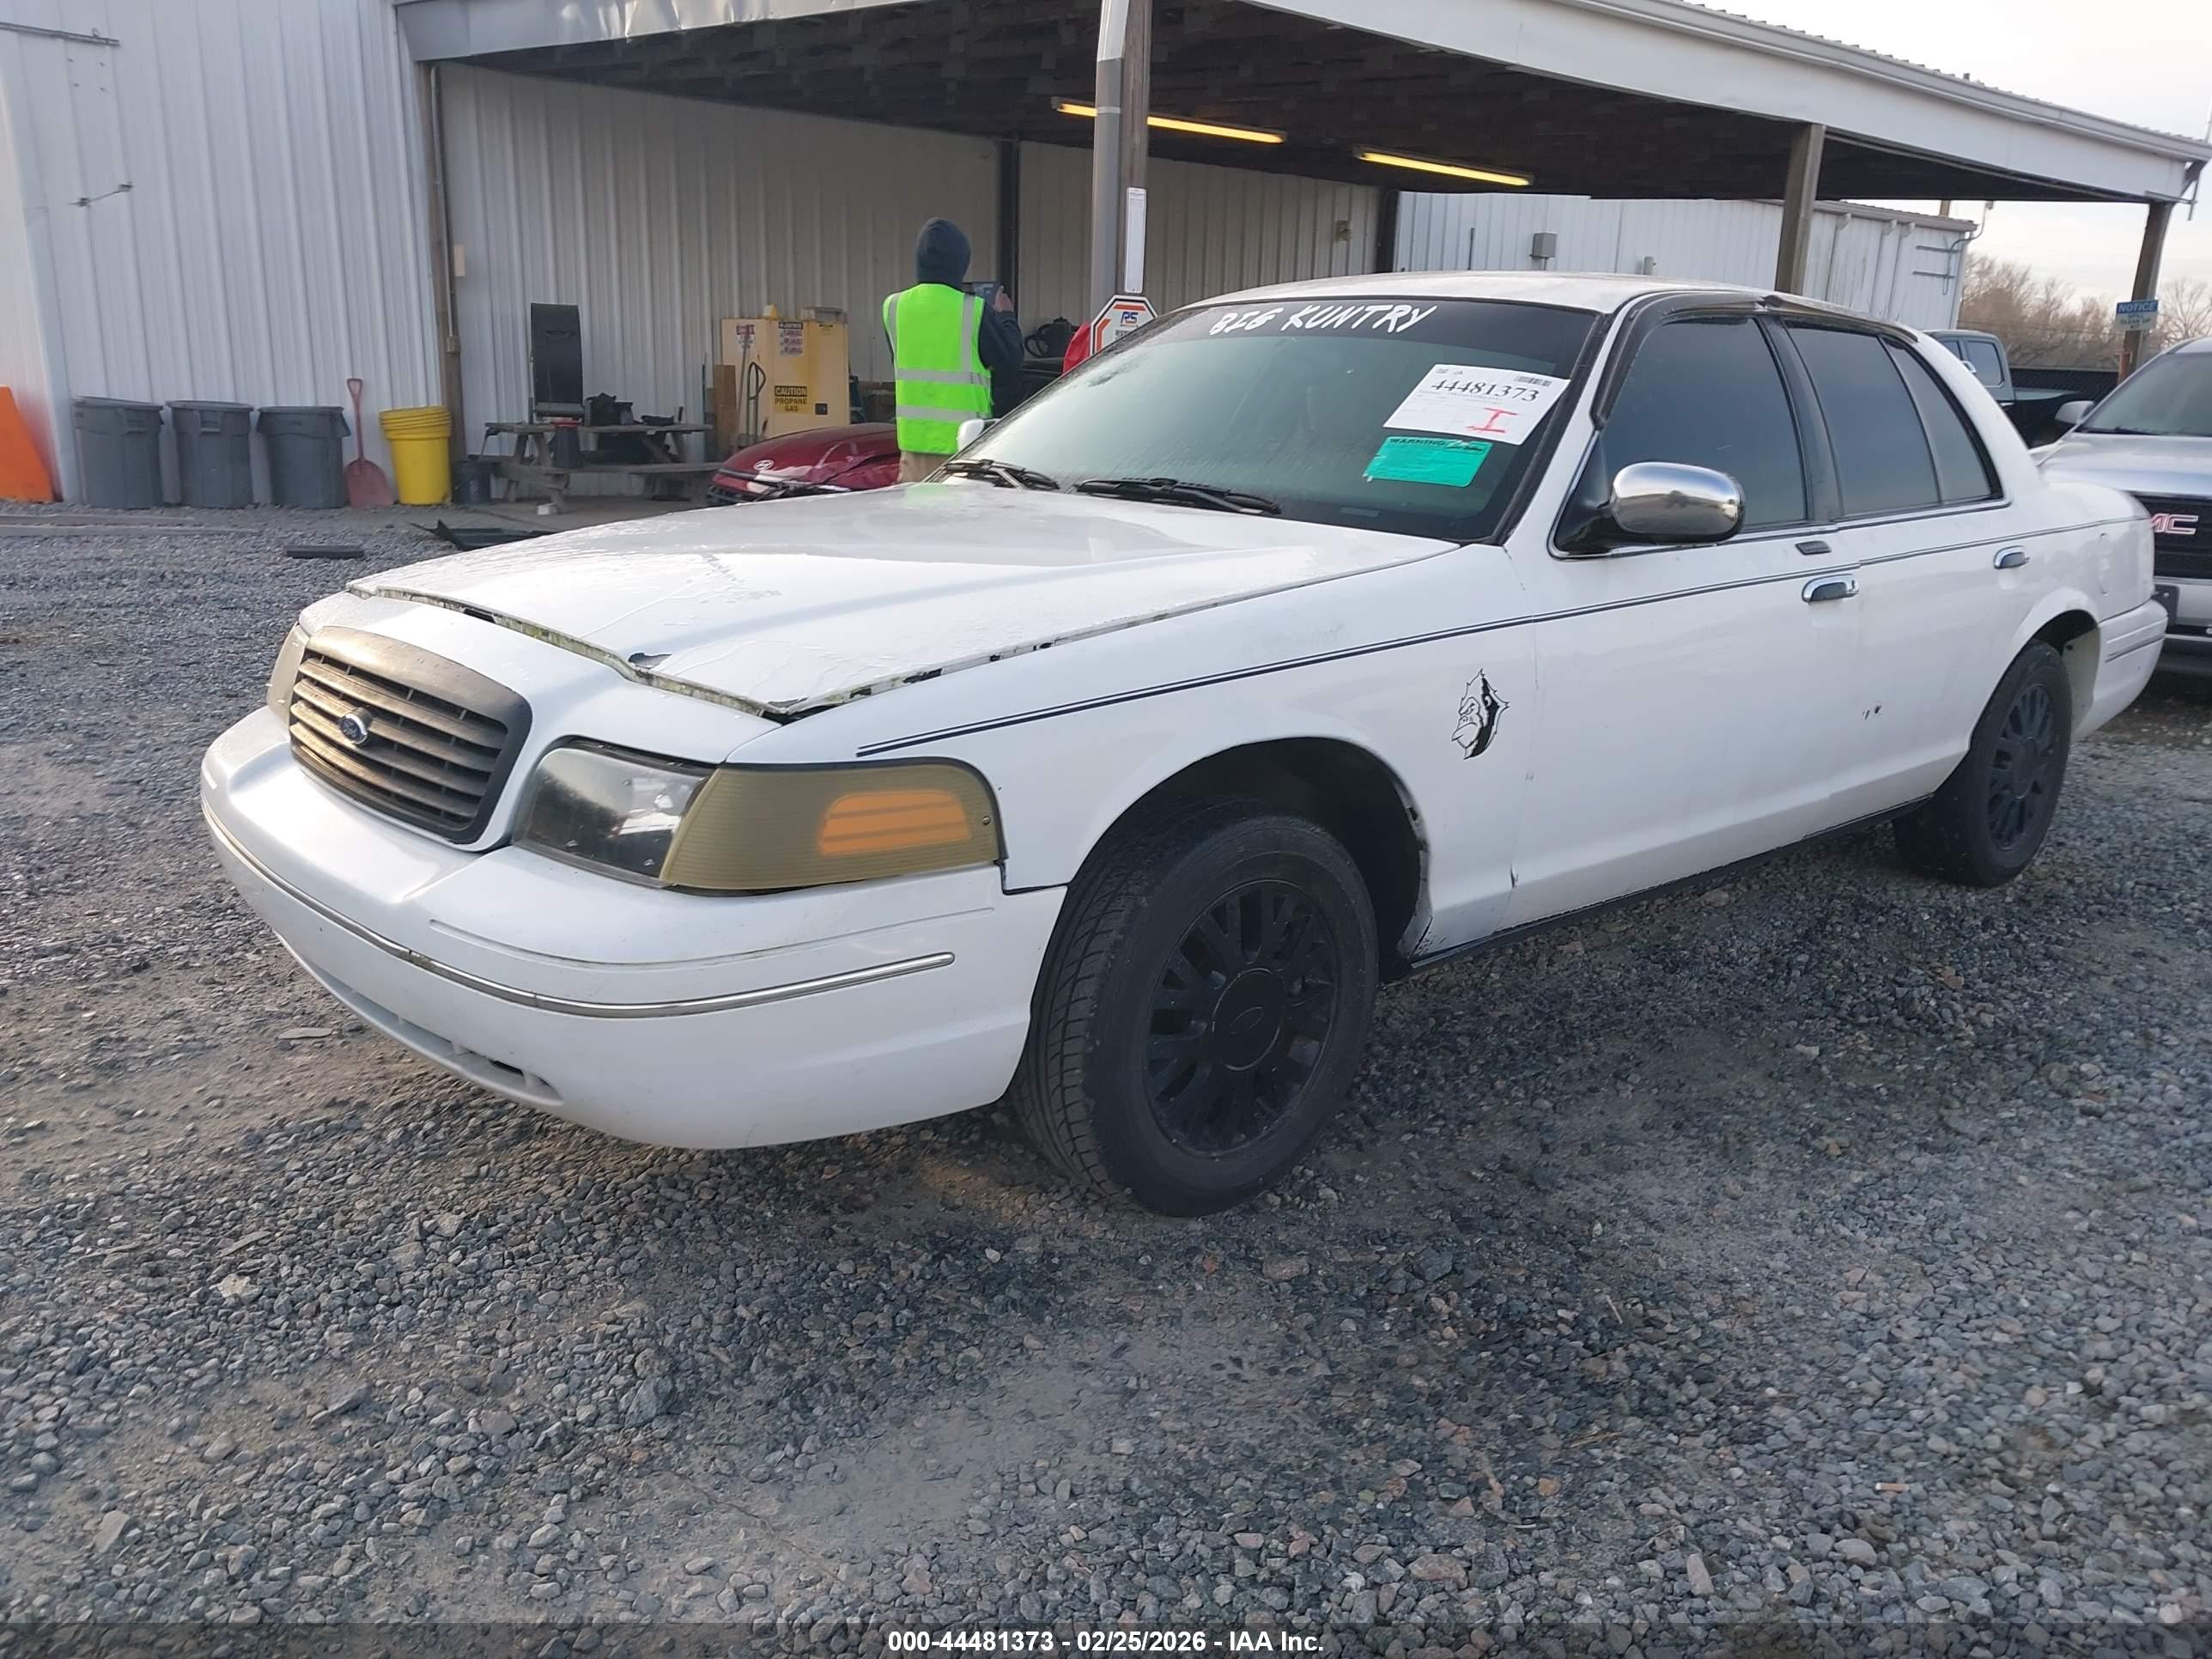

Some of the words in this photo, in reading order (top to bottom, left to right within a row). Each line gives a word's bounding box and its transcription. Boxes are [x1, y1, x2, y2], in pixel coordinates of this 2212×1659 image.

[2118, 301, 2157, 313] NOTICE
[1209, 307, 1284, 335] BIG
[1280, 305, 1437, 333] KUNTRY
[775, 386, 807, 396] CAUTION
[1431, 380, 1540, 402] 44481373
